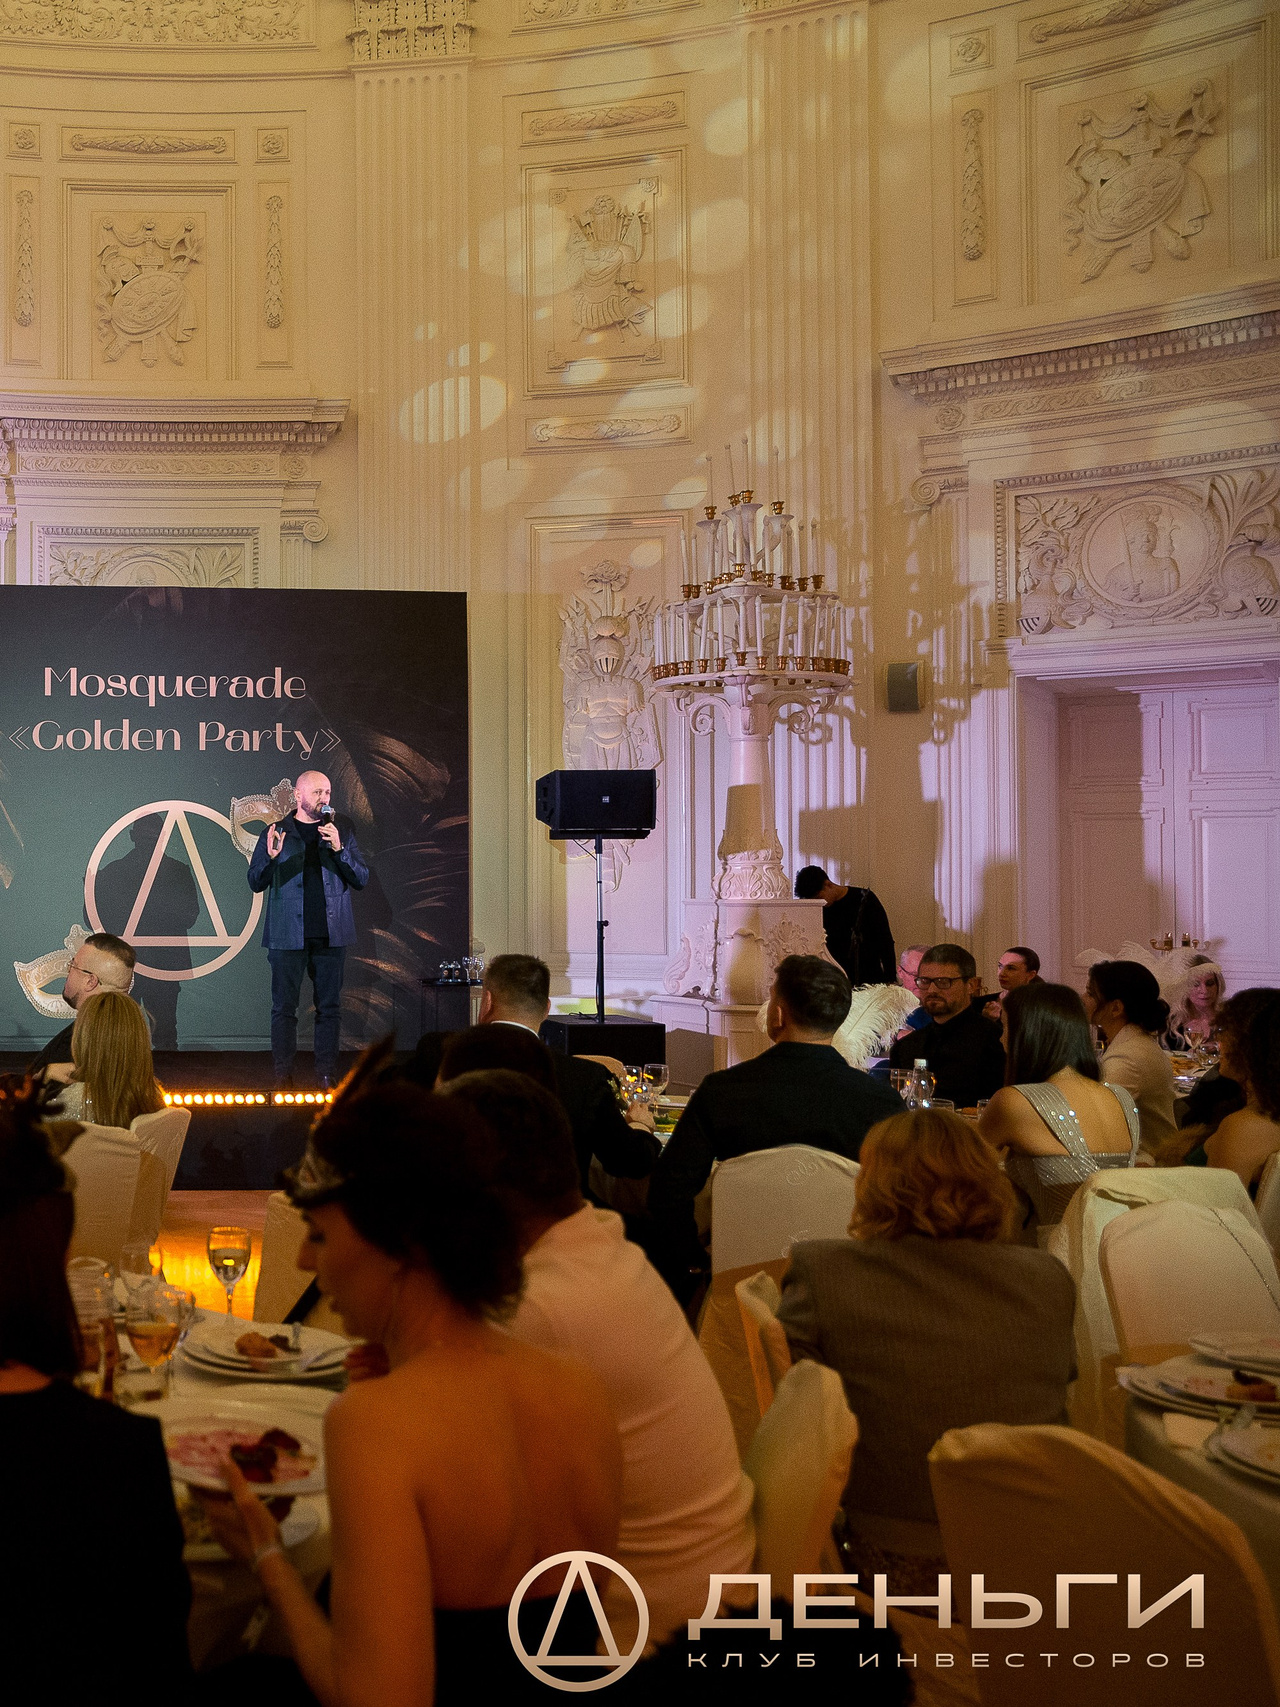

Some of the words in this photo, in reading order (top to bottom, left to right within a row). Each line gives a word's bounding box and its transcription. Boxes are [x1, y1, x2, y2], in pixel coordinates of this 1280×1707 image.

[44, 667, 306, 707] Mosquerade
[9, 719, 181, 751] «Golden
[199, 721, 341, 761] Party»
